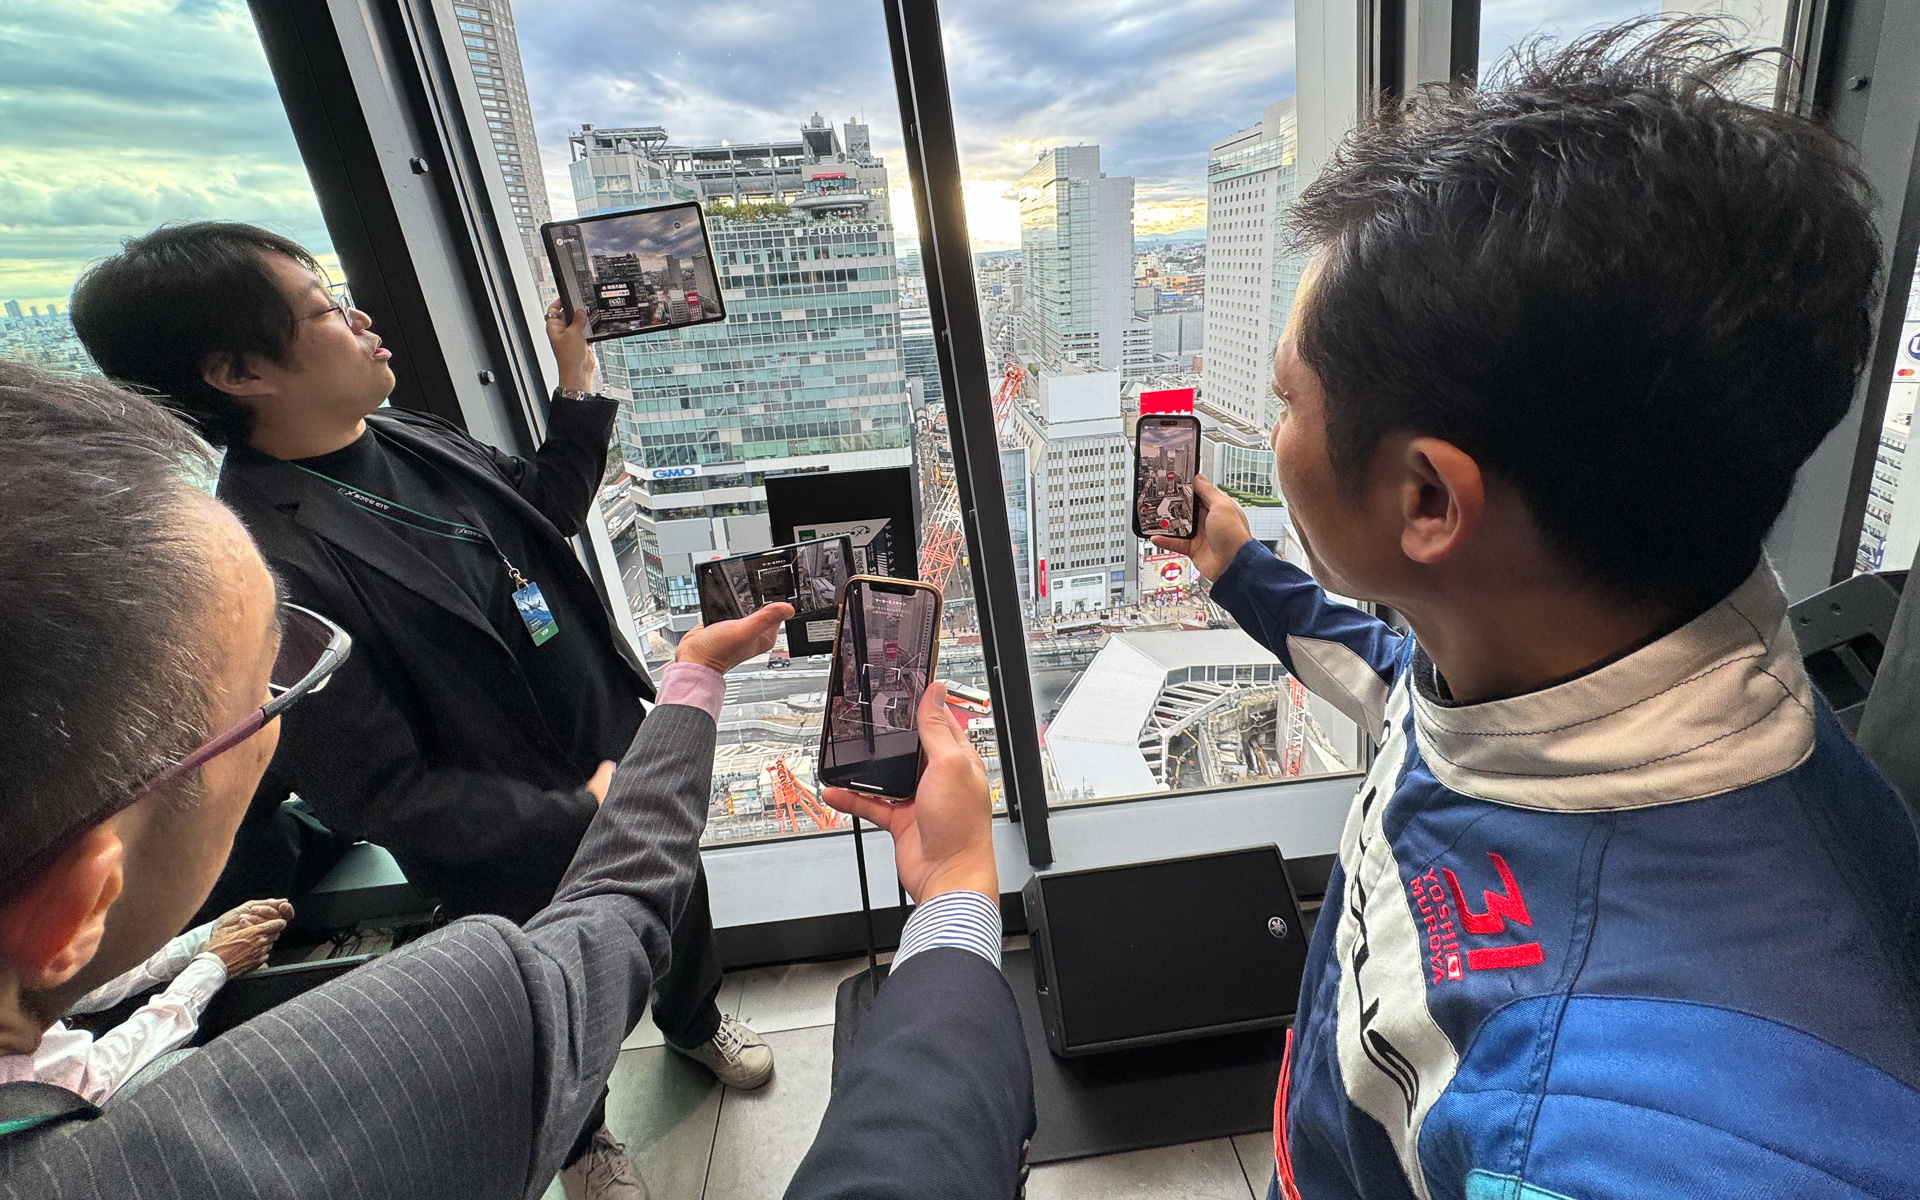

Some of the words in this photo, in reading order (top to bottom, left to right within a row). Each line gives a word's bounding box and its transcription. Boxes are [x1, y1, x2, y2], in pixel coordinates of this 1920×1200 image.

[808, 224, 879, 236] FUKURAS
[652, 467, 696, 479] GMO
[354, 493, 376, 505] RACE
[375, 502, 390, 510] AIR
[1423, 867, 1459, 951] YOSHI
[1441, 851, 1544, 971] 31
[1410, 876, 1445, 986] MUROYA
